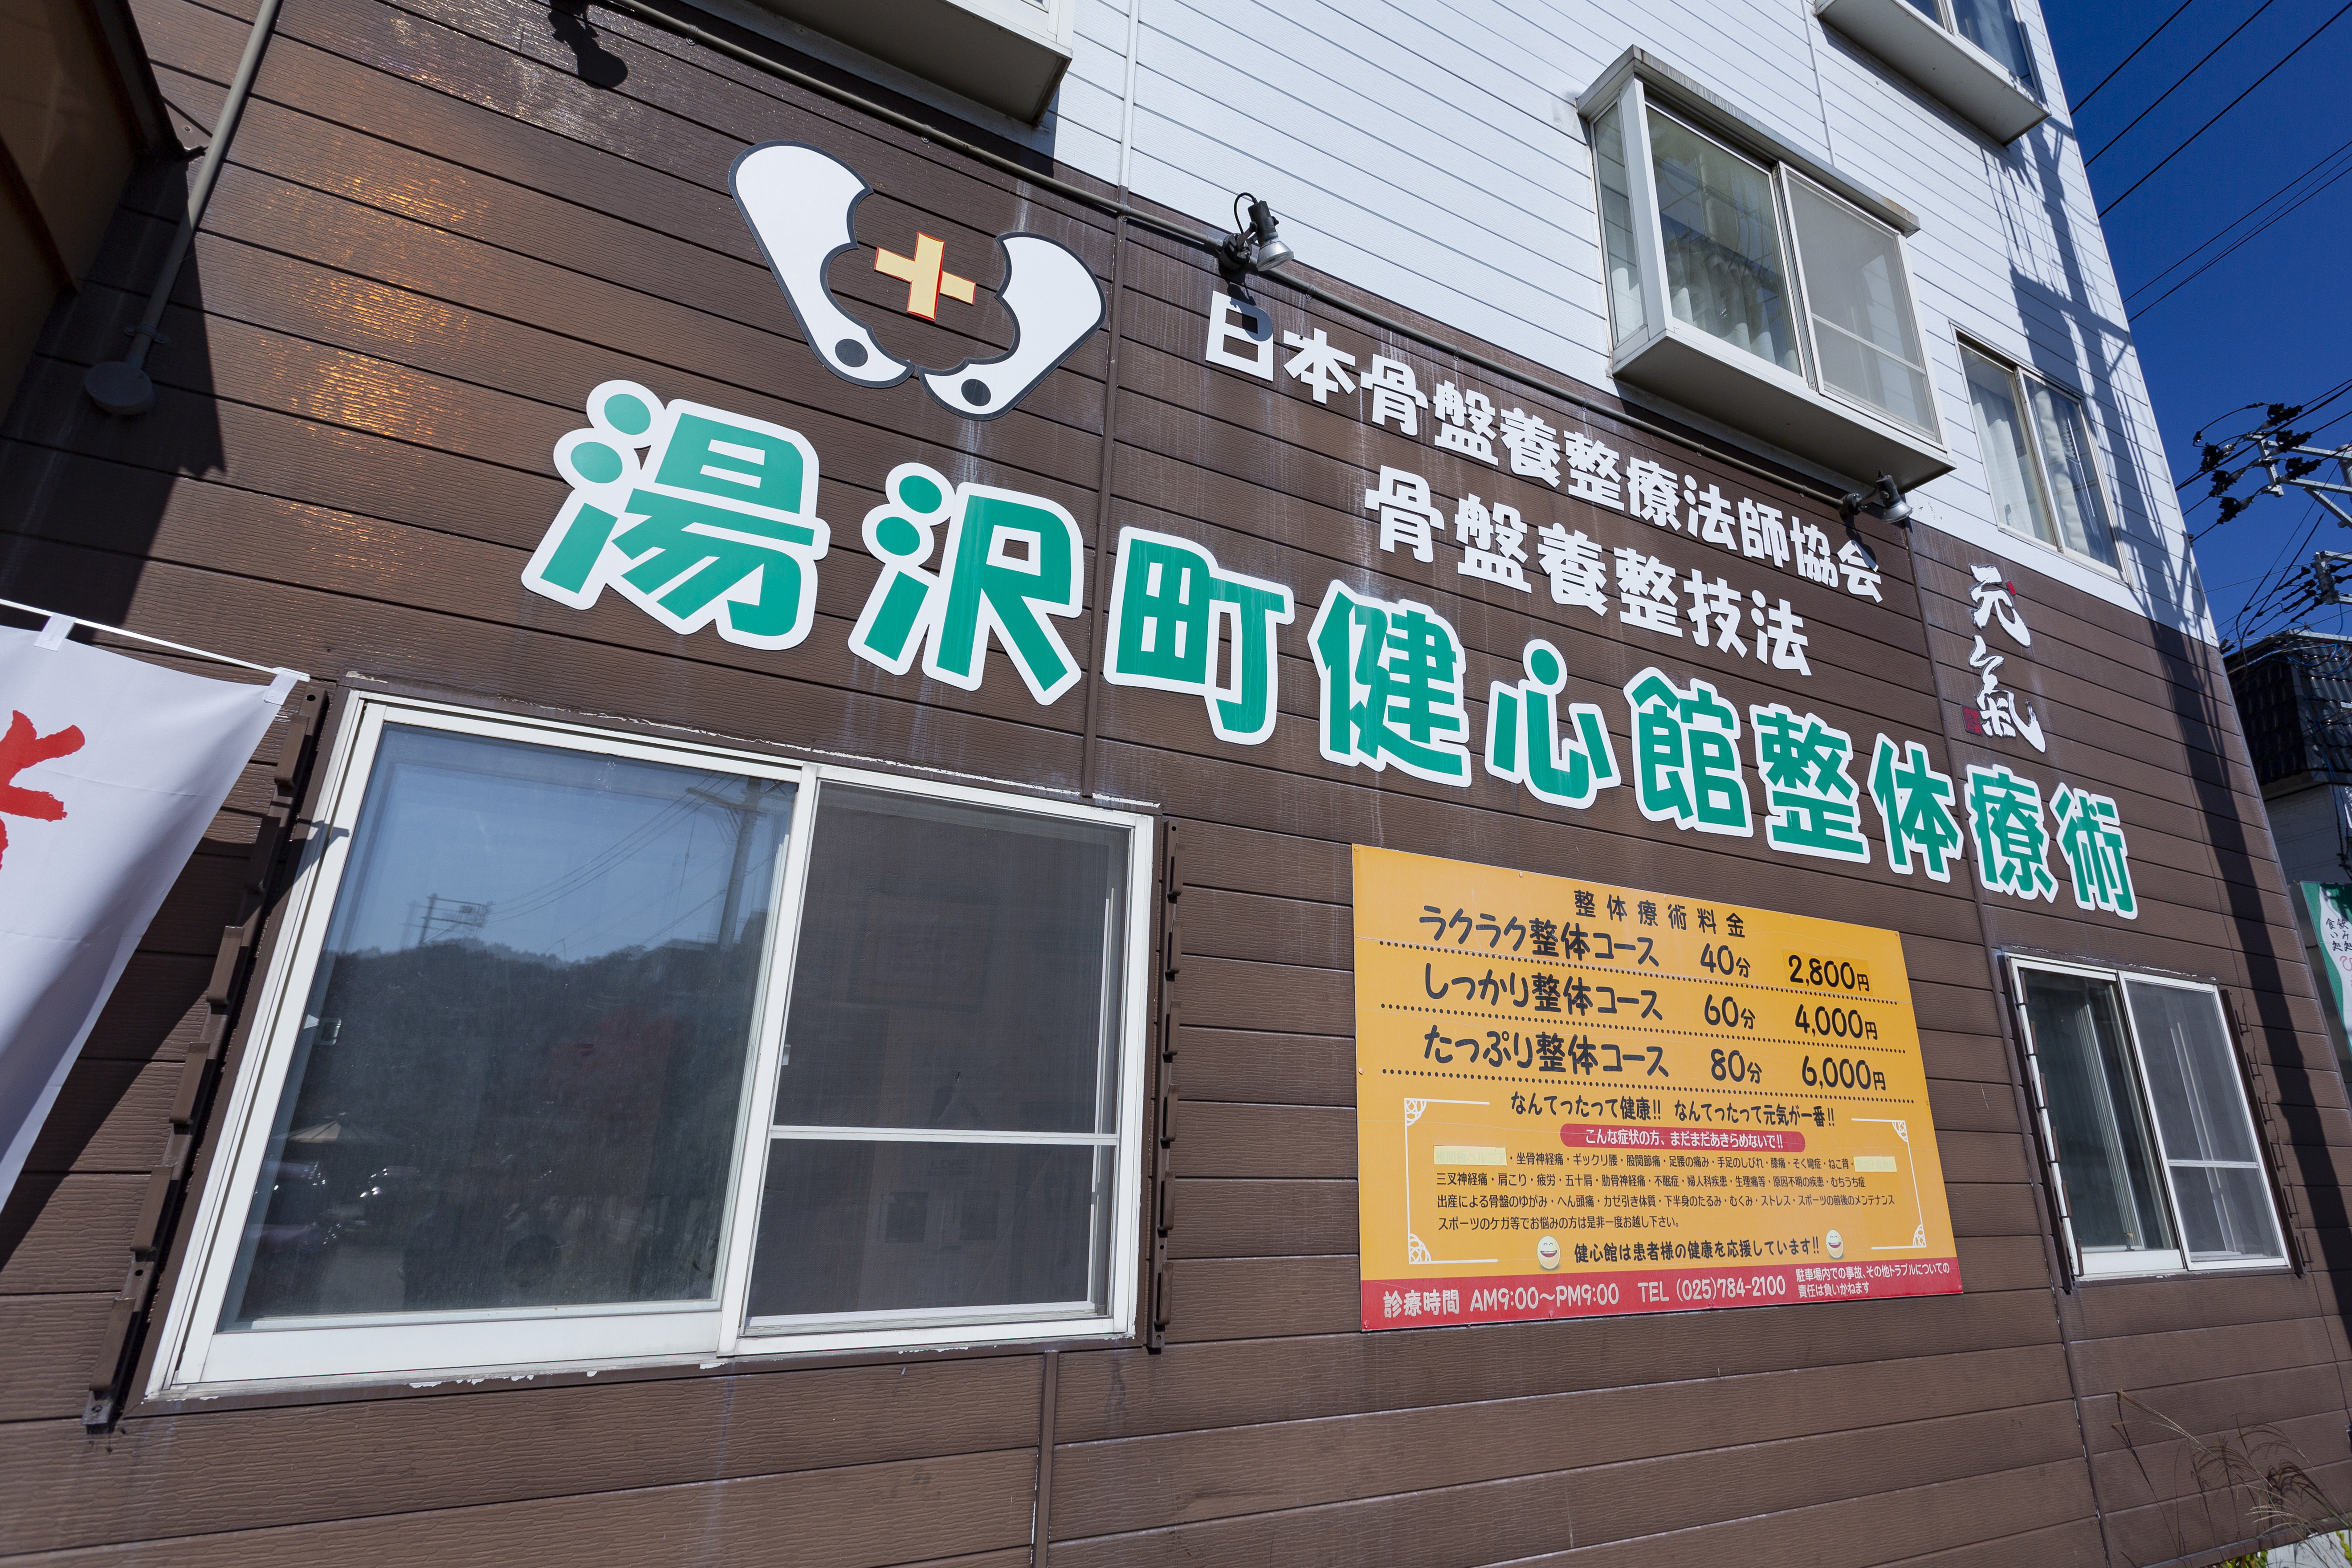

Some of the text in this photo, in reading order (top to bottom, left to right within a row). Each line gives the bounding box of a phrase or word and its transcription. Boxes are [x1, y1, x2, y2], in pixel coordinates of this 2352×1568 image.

[1206, 290, 1883, 603] 日本骨盤養整療法師協会
[1361, 465, 1812, 676] 骨盤養整技法
[521, 380, 2138, 920] 湯沢町健心館整体療術
[1419, 905, 1869, 991] ラクラク整体コース 40分 2,800円
[1574, 890, 1745, 937] 整体療術料金
[1426, 963, 1877, 1040] しっかり整体コース 60分 4,000円
[1424, 1025, 1886, 1090] たっぷり整体コース 80分 6,000円
[1383, 1289, 1459, 1318] 診療時間
[1638, 1281, 1669, 1302] TEL
[1677, 1275, 1785, 1301] (025)784-2100
[1798, 1282, 1869, 1298] 責任は負いかねます
